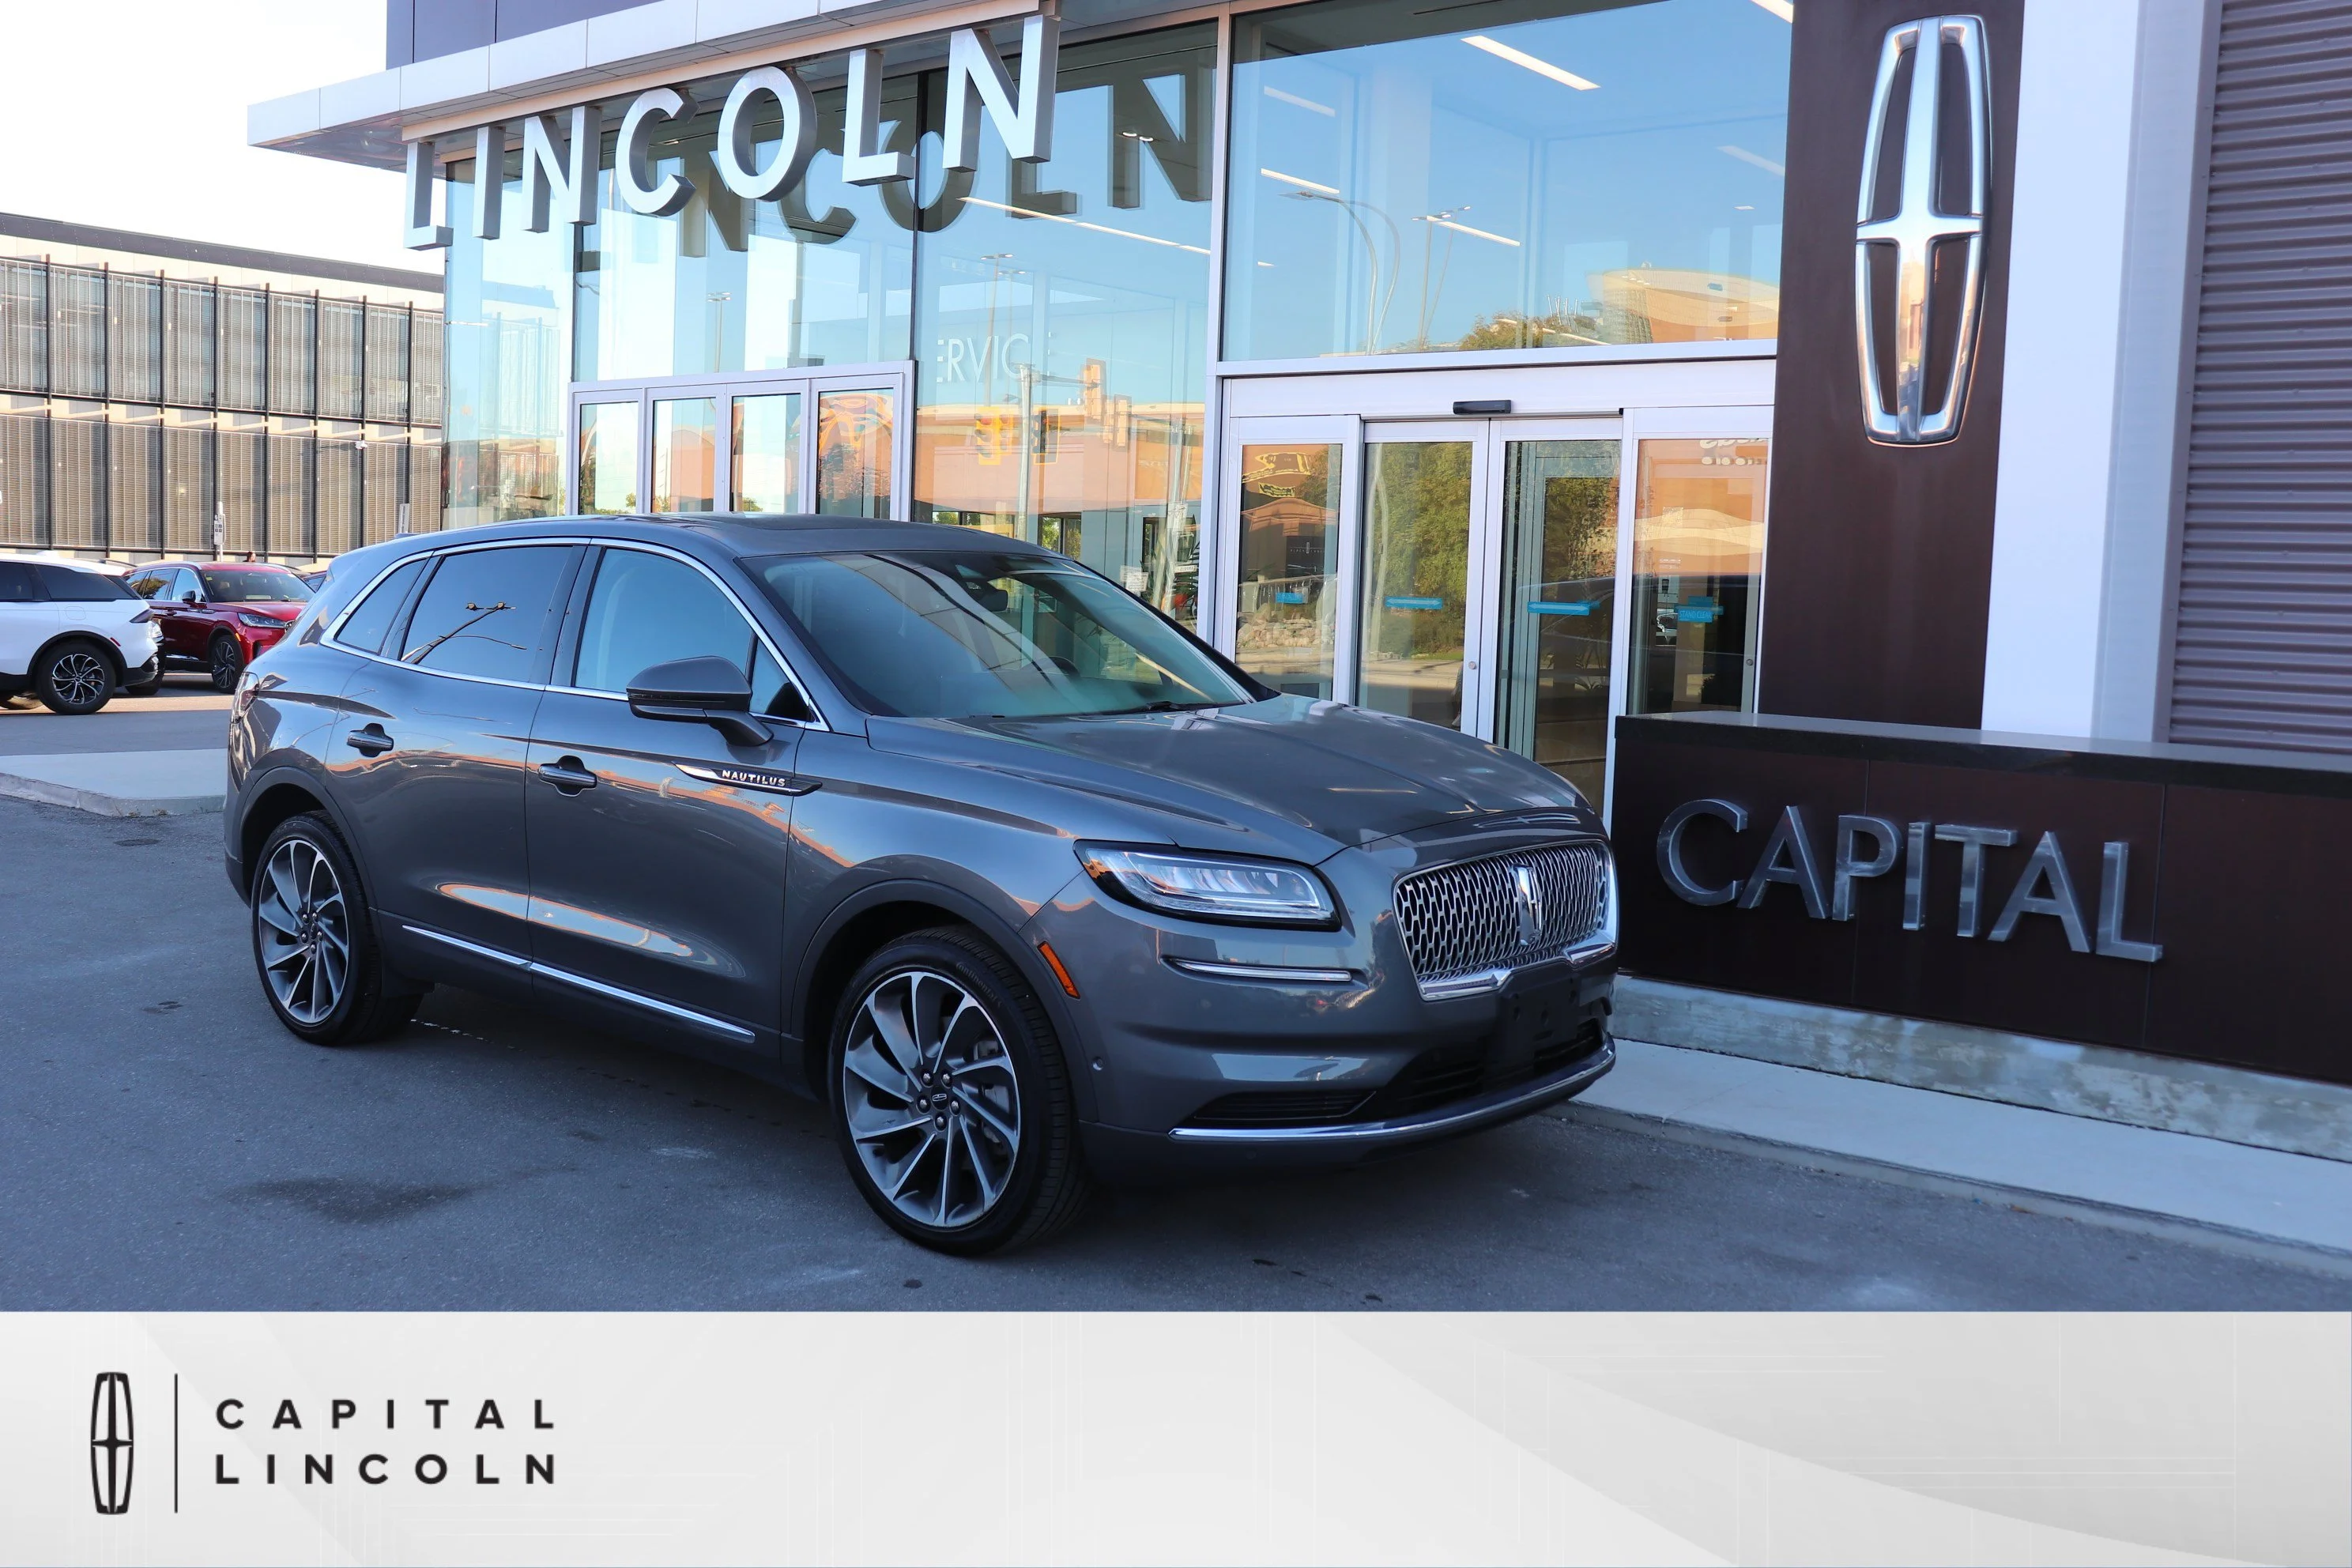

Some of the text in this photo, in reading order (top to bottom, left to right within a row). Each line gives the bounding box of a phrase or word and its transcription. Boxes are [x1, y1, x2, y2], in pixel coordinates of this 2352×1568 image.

[404, 14, 1060, 251] LINCOLN
[722, 770, 786, 787] NAUTILUS
[1657, 798, 2163, 963] CAPITAL
